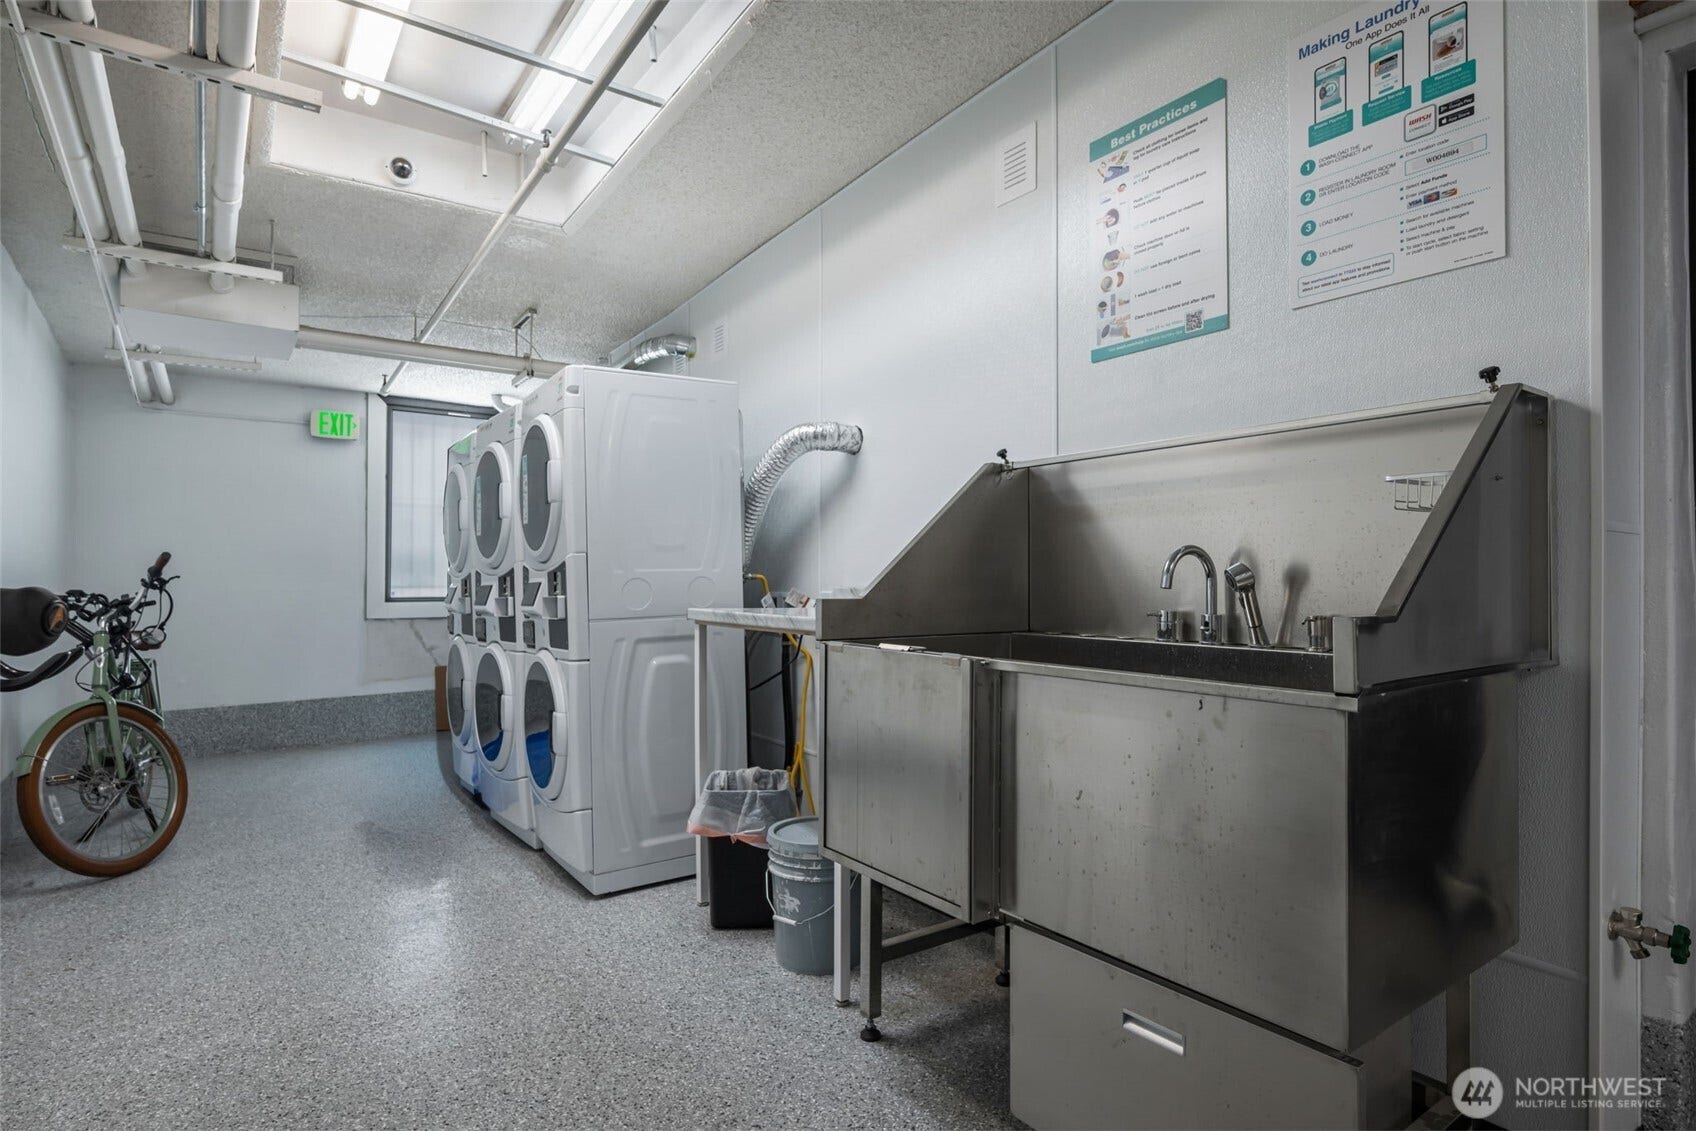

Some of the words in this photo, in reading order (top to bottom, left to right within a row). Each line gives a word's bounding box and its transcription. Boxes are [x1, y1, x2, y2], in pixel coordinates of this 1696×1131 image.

[1299, 28, 1350, 60] Making
[1355, 0, 1419, 33] Laundry
[1345, 38, 1362, 50] One
[1366, 29, 1382, 42] App
[1384, 16, 1408, 32] Does
[1410, 12, 1416, 20] It
[1418, 5, 1430, 16] All
[1110, 129, 1136, 148] Best
[1139, 100, 1197, 134] Practices
[1306, 162, 1310, 171] 1
[1304, 193, 1311, 202] 2
[1305, 223, 1312, 232] 3
[1306, 253, 1312, 261] 4
[319, 411, 354, 436] EXIT
